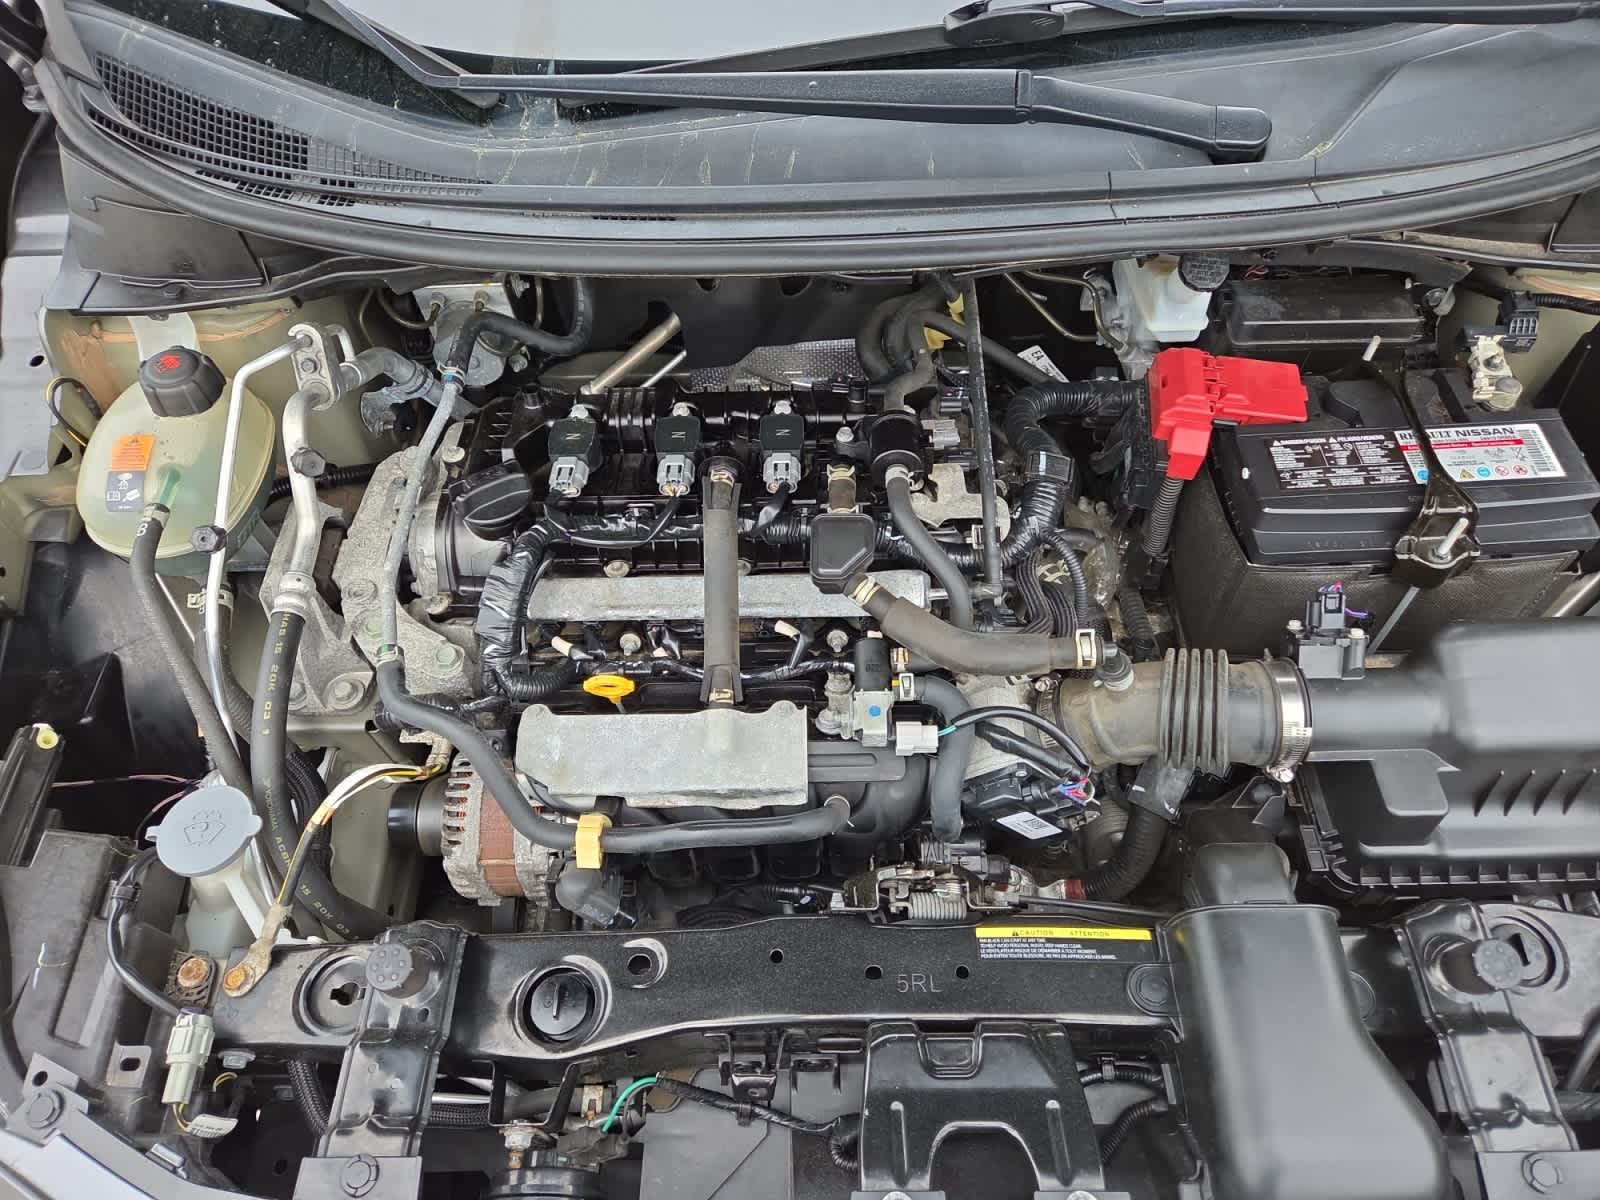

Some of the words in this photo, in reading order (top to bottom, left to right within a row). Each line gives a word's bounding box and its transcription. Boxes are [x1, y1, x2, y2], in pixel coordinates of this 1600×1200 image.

[1455, 427, 1514, 437] NISSAN
[1019, 929, 1055, 937] CAUTION
[1069, 930, 1110, 938] ATTENTION
[897, 973, 945, 993] 5RL
